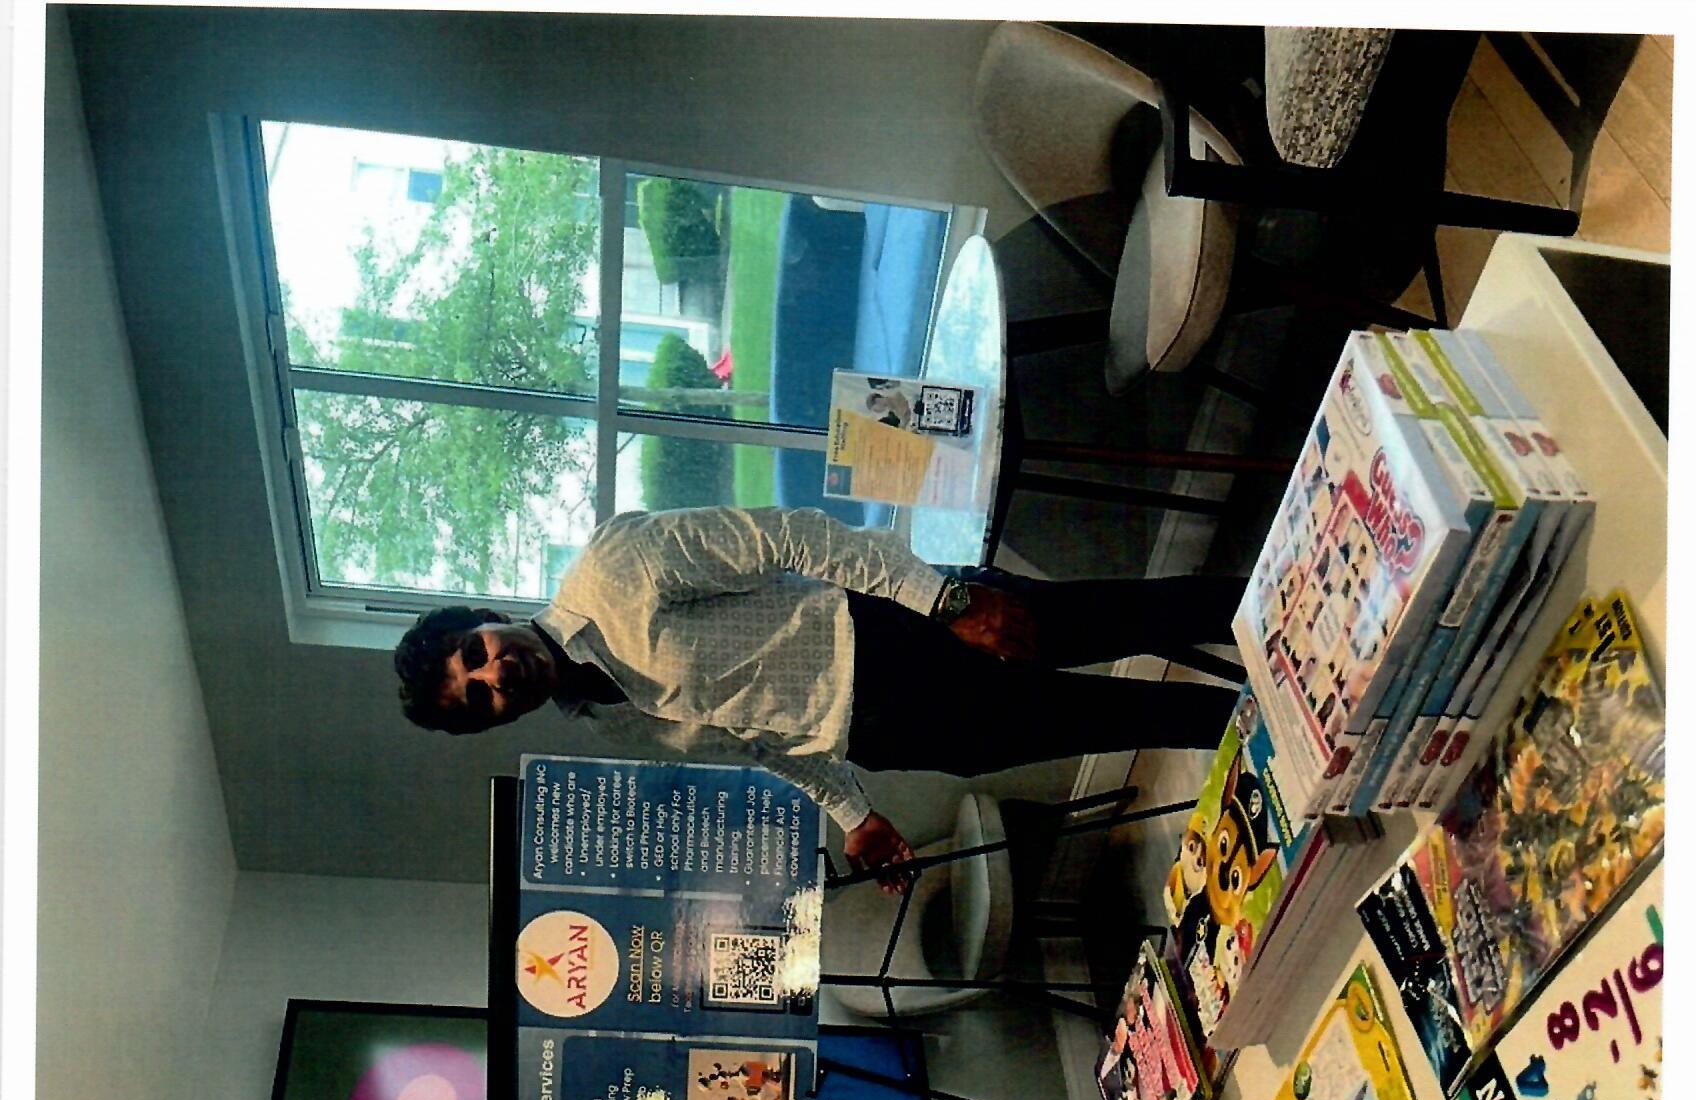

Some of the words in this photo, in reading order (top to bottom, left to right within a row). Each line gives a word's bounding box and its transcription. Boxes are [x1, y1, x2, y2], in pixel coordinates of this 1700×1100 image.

[552, 782, 561, 805] new
[568, 771, 576, 791] are
[612, 770, 622, 806] career
[626, 776, 637, 818] Biotech
[746, 784, 757, 806] Job
[534, 786, 548, 844] Consulting
[566, 792, 576, 816] who
[596, 776, 608, 832] employed
[610, 808, 620, 824] for
[656, 803, 668, 829] High
[760, 788, 774, 813] help
[775, 806, 786, 825] Aid
[550, 807, 560, 863] welcomes
[579, 788, 592, 863] Unemployed/
[626, 820, 636, 830] to
[640, 801, 651, 845] Pharma
[655, 831, 664, 843] or
[672, 809, 683, 832] only
[684, 784, 697, 872] Pharmaceutical
[700, 806, 710, 848] Biotech
[714, 791, 728, 873] manufacturing
[790, 814, 800, 830] for
[564, 818, 575, 875] candidate
[595, 834, 604, 866] under
[609, 826, 623, 868] Looking
[624, 833, 635, 868] switch
[639, 847, 649, 870] and
[654, 844, 664, 868] GED
[670, 834, 680, 871] school
[743, 808, 756, 875] Guaranteed
[758, 815, 771, 876] placement
[773, 826, 785, 876] Financial
[788, 832, 800, 877] covered
[533, 847, 546, 878] Aryan
[700, 850, 709, 872] and
[628, 924, 643, 960] Now
[650, 930, 664, 952] QR
[567, 924, 588, 1010] ARYAN
[627, 963, 642, 1002] Scan
[648, 956, 662, 1003] below
[1628, 942, 1664, 994] 6
[1546, 1000, 1581, 1050] 8
[622, 1068, 634, 1093] Prep
